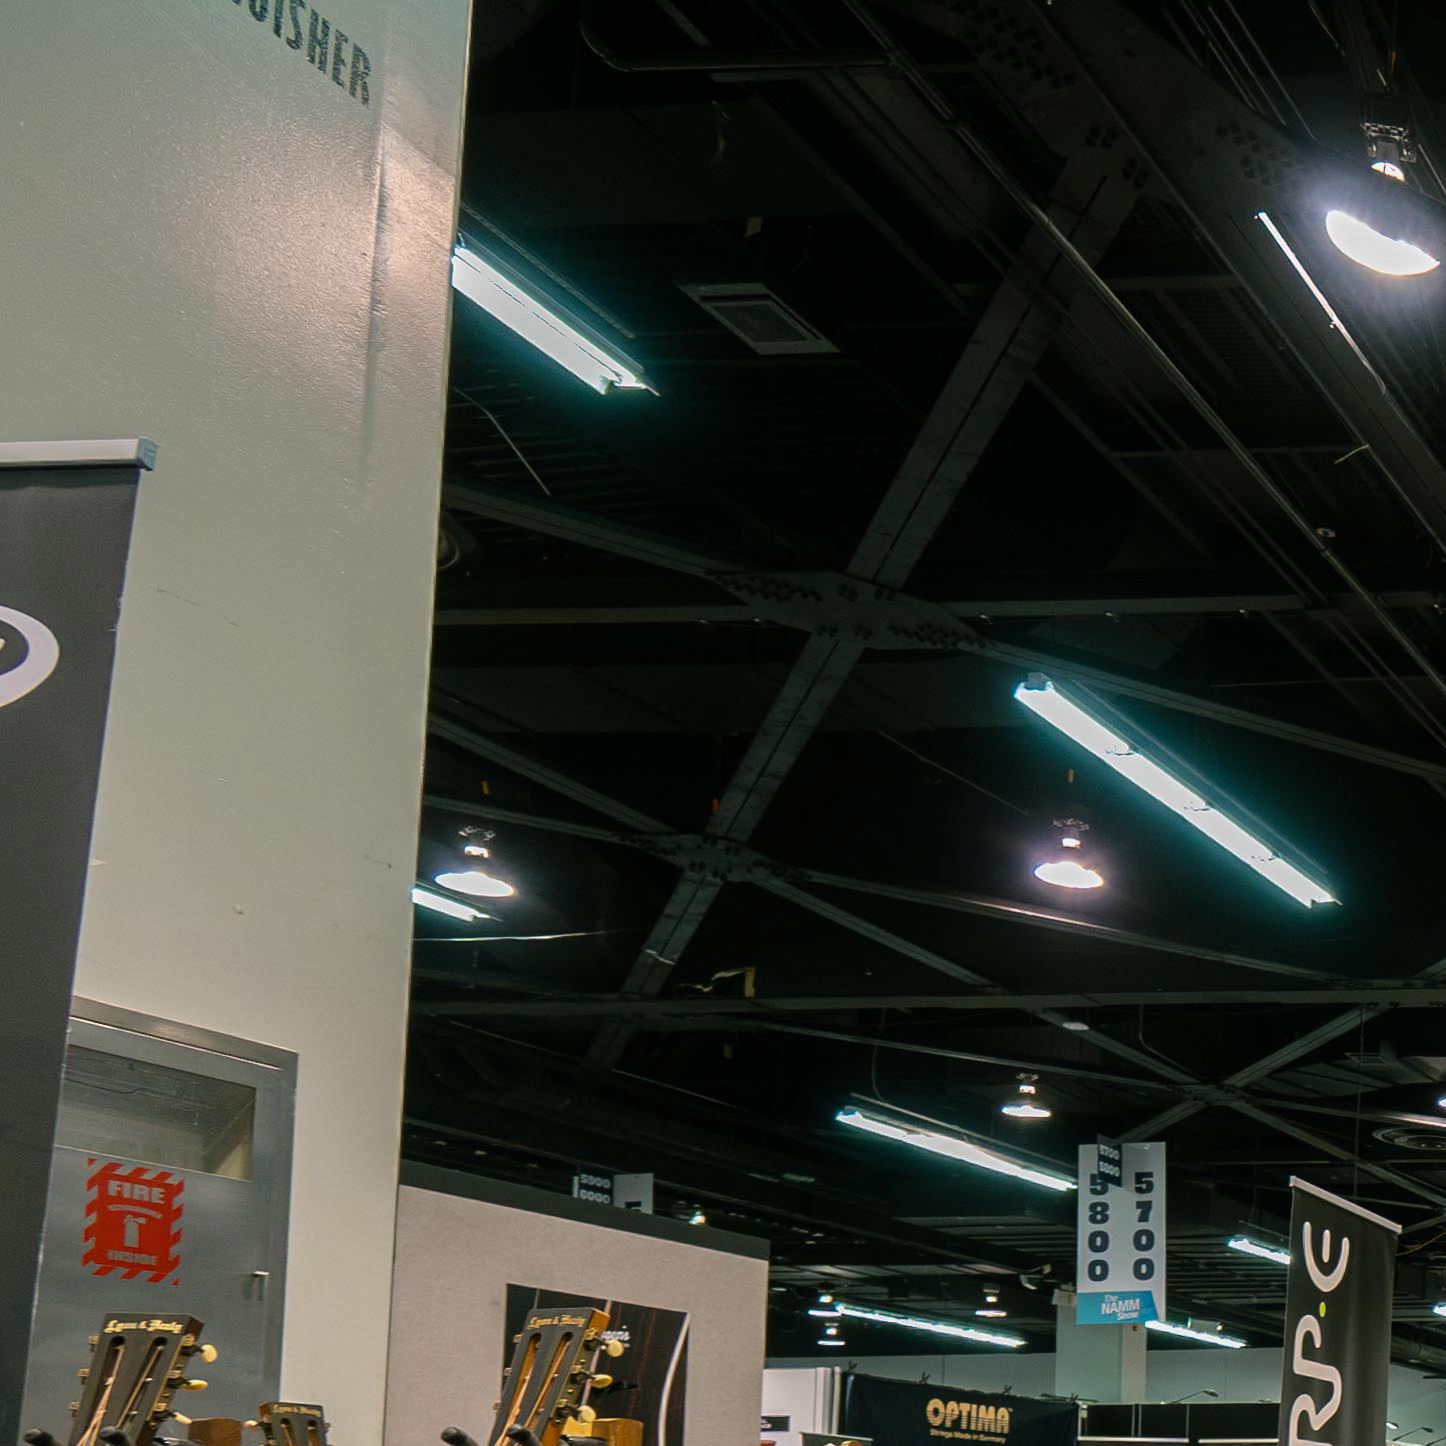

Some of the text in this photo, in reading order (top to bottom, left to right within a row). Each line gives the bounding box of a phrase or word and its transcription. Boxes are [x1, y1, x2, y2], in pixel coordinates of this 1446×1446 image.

[108, 1179, 166, 1205] FIRE
[1088, 1173, 1110, 1282] 5800
[1133, 1171, 1155, 1281] 5700
[1101, 1299, 1141, 1315] NAMM
[926, 1398, 1010, 1434] OPTIMA
